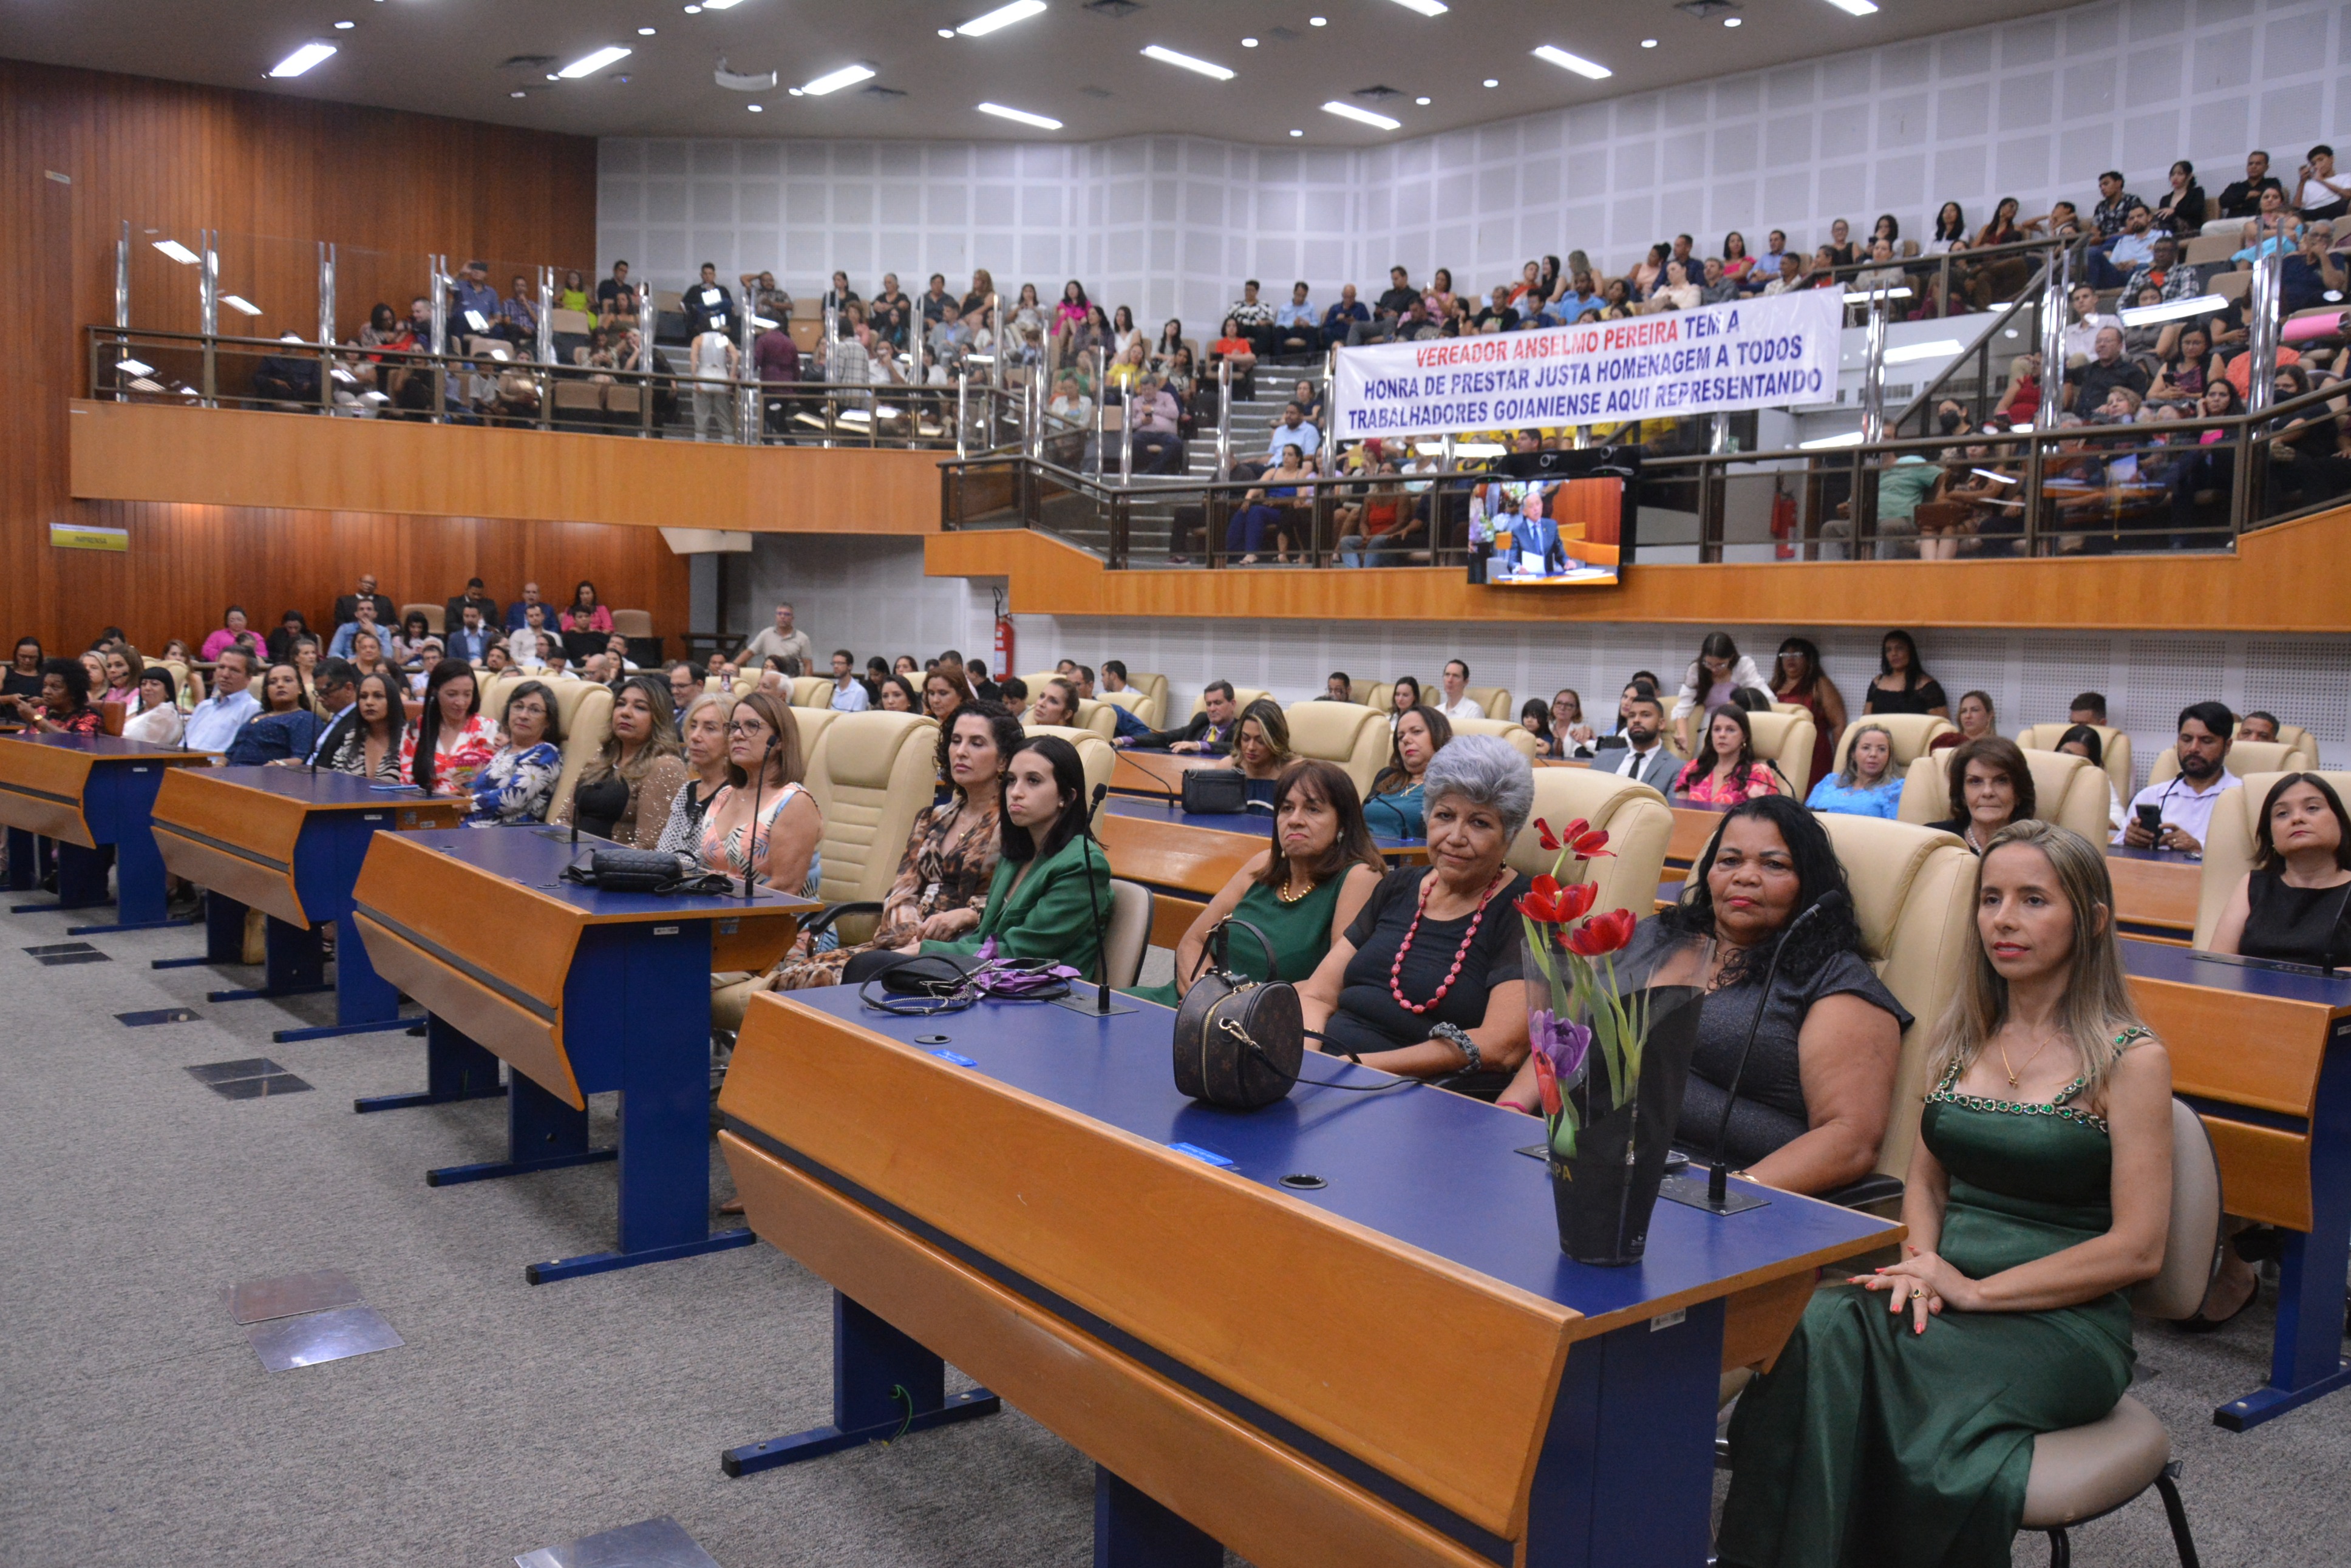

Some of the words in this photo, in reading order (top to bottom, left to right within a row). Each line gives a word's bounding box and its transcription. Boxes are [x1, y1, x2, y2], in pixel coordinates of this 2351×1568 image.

[1364, 377, 1420, 401] HONRA
[1424, 375, 1446, 396] DE
[1451, 368, 1529, 395] PRESTAR
[1535, 362, 1591, 389] JUSTA
[1596, 346, 1712, 383] HOMENAGEM
[1715, 344, 1730, 368] A
[1737, 334, 1803, 366] TODOS
[1417, 340, 1508, 368] VEREADOR
[1513, 331, 1599, 360] ANSELMO
[1604, 319, 1678, 351] PEREIRA
[1685, 311, 1722, 339] TEM
[1727, 309, 1740, 334] A
[1348, 401, 1488, 430] TRABALHADORES
[1494, 392, 1602, 422] GOIANIENSE
[1606, 387, 1650, 413] AQUI
[1655, 367, 1823, 409] REPRESENTANDO
